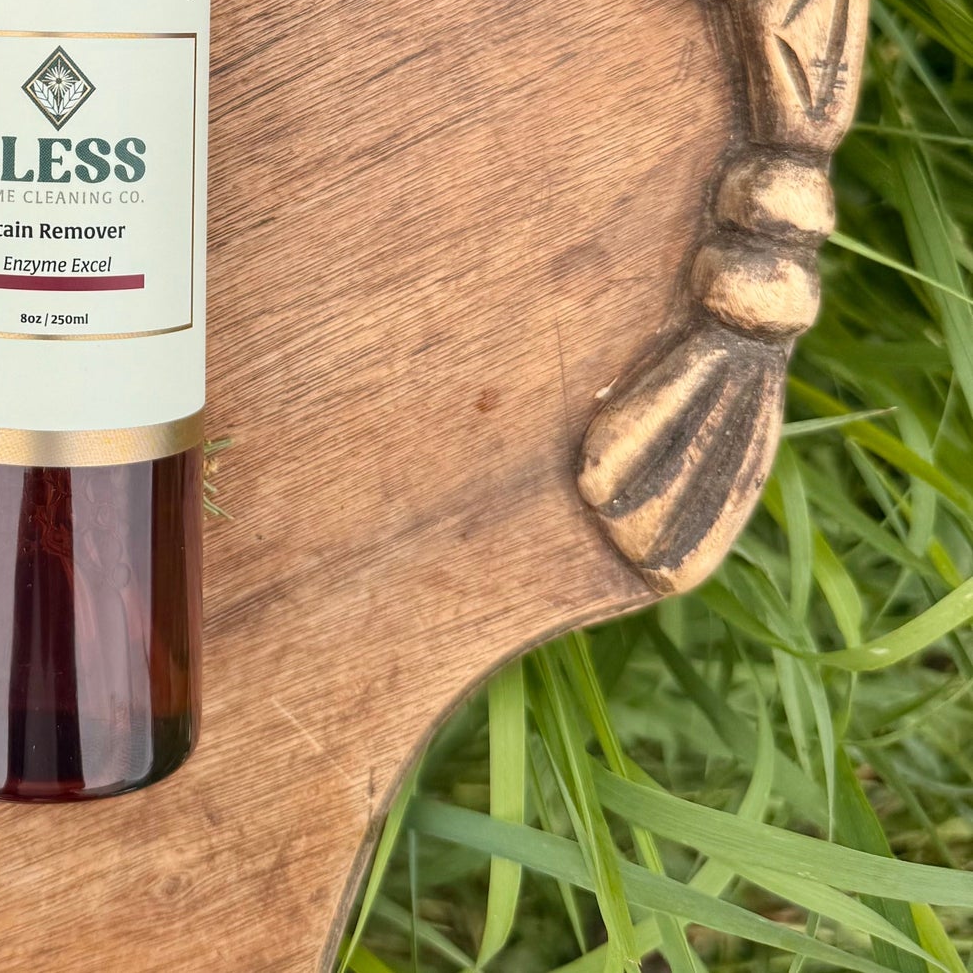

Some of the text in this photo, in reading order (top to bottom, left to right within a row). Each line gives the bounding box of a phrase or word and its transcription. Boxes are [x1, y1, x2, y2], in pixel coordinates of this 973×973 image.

[23, 190, 113, 205] CLEANING
[119, 190, 145, 204] CO.
[39, 223, 126, 240] Remover
[3, 256, 112, 276] Enzyme Excel
[20, 313, 42, 324] 8oz
[50, 313, 89, 326] 250ml
